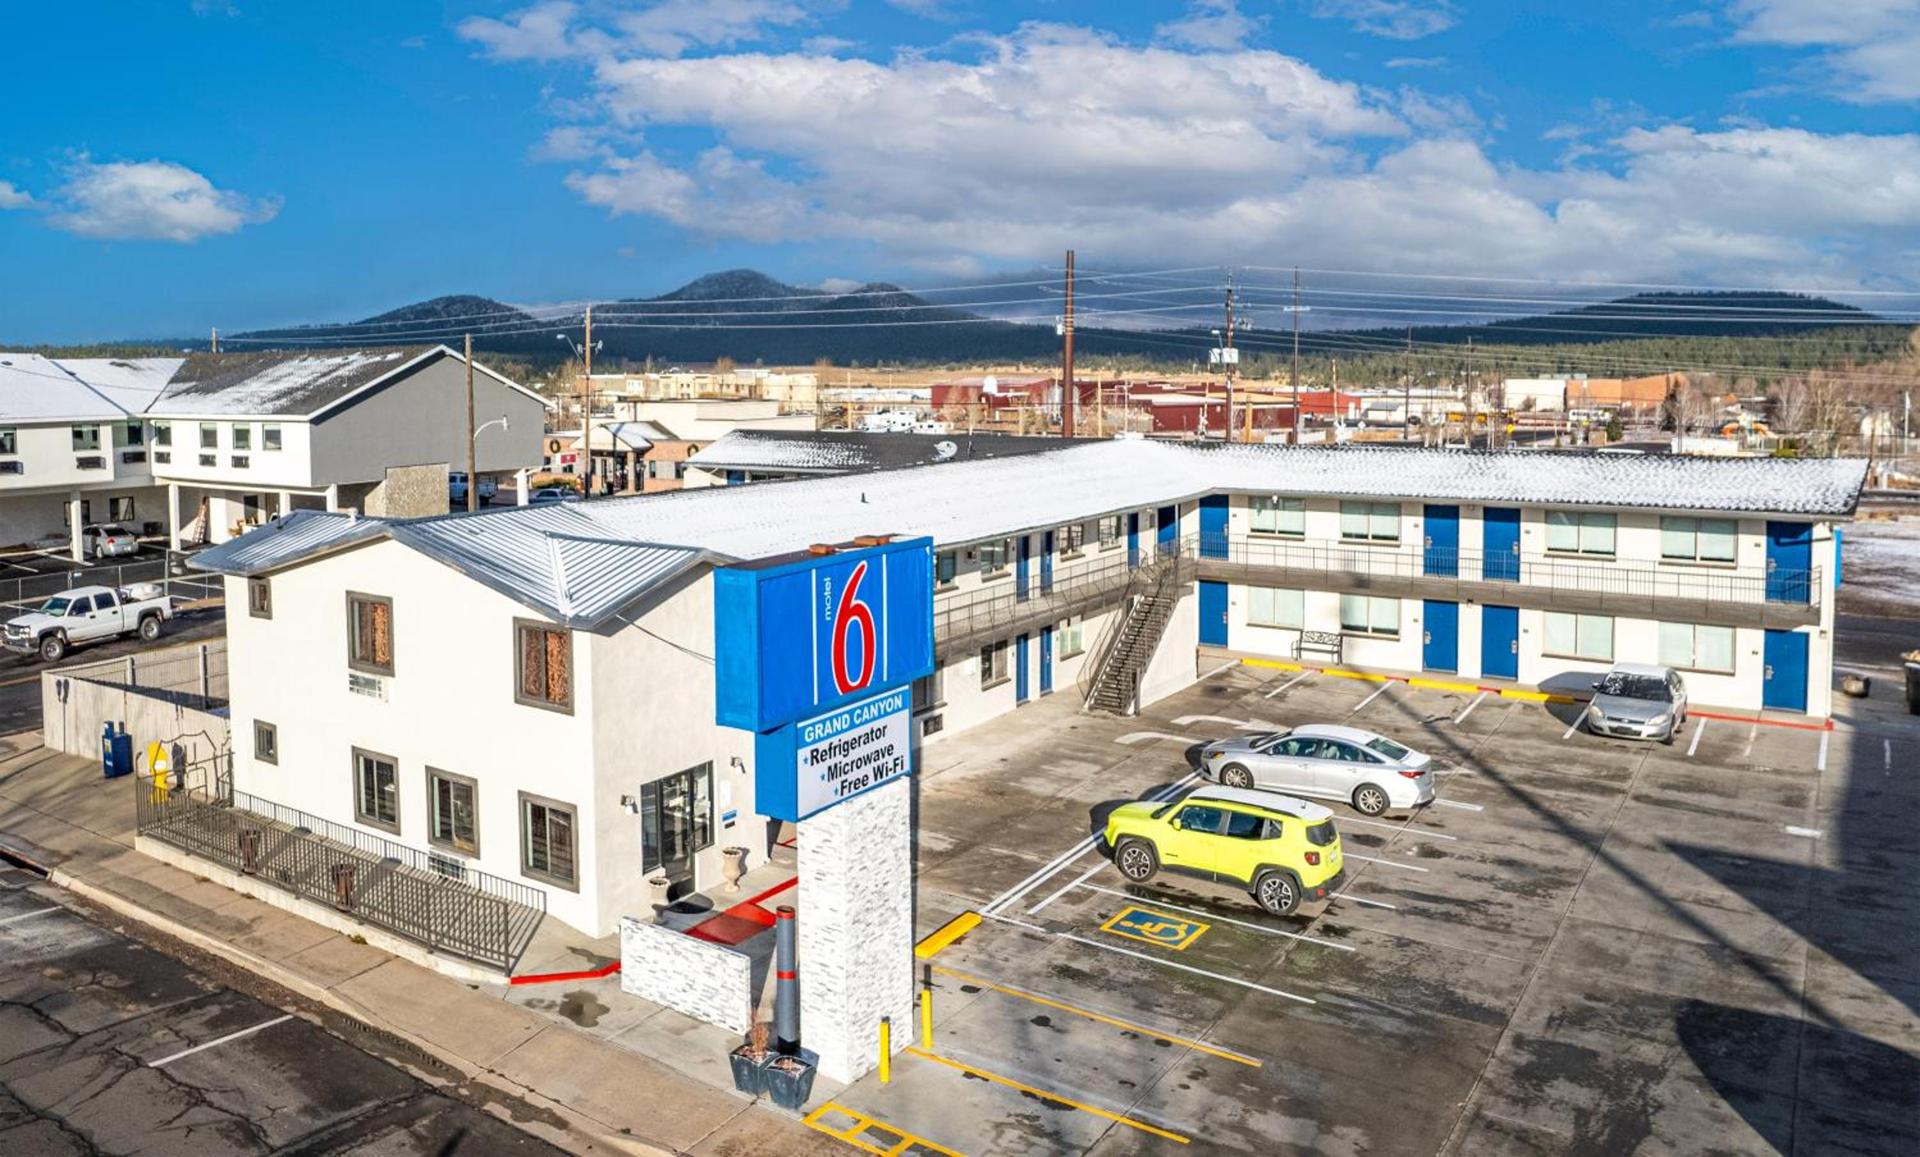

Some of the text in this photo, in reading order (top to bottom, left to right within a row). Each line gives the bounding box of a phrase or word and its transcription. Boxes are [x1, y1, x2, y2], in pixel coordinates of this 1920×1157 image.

[831, 560, 876, 696] 6
[804, 695, 903, 742] GRAND CANYON
[810, 725, 888, 766] Refrigerator
[827, 744, 894, 782] Microwave
[840, 755, 904, 796] Free Wi-Fi
